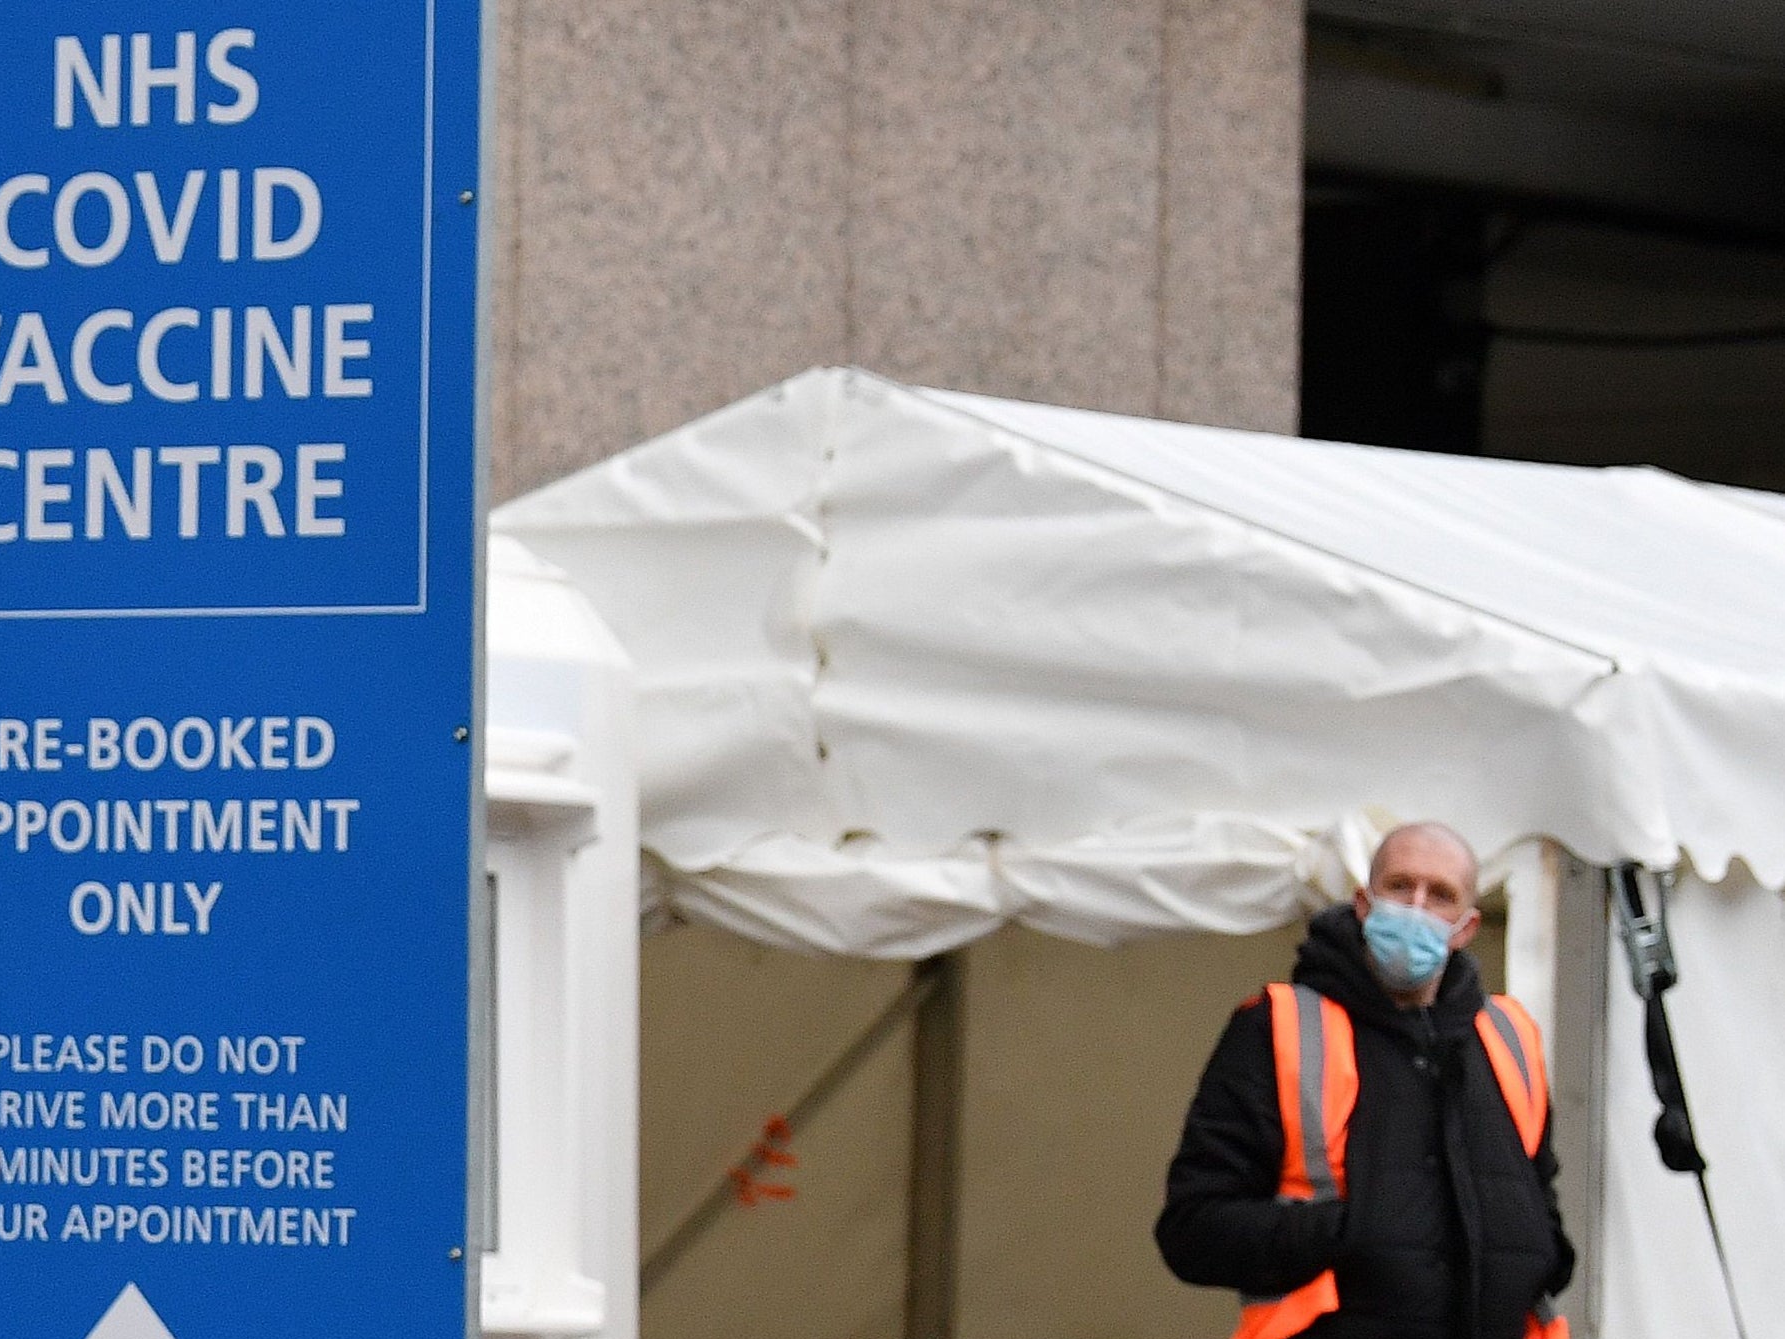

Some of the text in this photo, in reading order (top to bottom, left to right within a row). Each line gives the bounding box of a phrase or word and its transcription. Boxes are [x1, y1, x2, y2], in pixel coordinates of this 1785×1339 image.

[55, 28, 258, 128] NHS
[70, 882, 222, 934] ONLY
[143, 1036, 203, 1073] DO
[219, 1037, 304, 1073] NOT
[101, 1092, 218, 1130] MORE
[234, 1093, 346, 1130] THAN
[183, 1150, 333, 1188] BEFORE
[62, 1205, 356, 1245] APPOINTMENT
